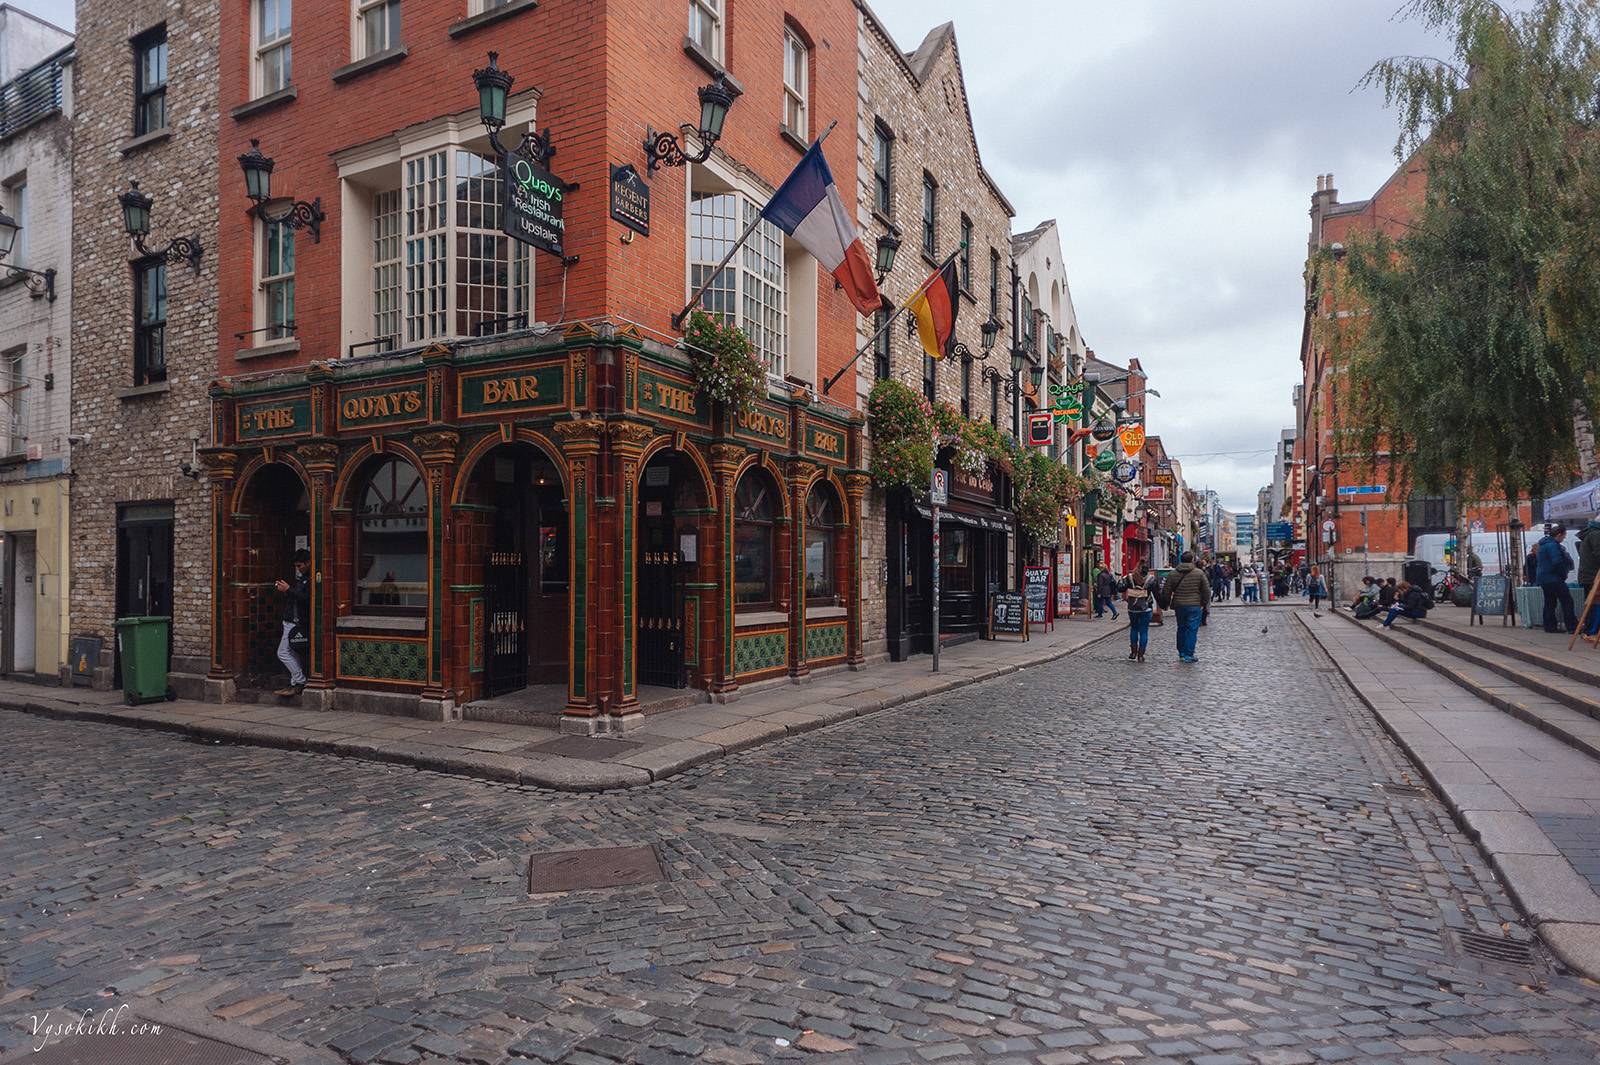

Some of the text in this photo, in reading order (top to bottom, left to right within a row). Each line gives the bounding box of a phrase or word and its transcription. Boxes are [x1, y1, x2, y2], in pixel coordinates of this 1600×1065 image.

[515, 159, 562, 202] Quays
[530, 194, 551, 212] Irish
[614, 181, 648, 209] REGENT
[514, 197, 565, 231] Restaurant
[615, 195, 648, 221] BARBERS
[521, 217, 558, 243] Upstairs
[483, 375, 539, 404] BAR
[655, 382, 697, 415] THE
[1048, 383, 1084, 395] Quays
[253, 406, 295, 431] THE
[814, 429, 838, 454] BAR
[1124, 432, 1143, 440] OLD
[1025, 569, 1050, 577] QUAYS
[1481, 577, 1502, 586] FREE
[1028, 609, 1045, 622] PEN
[1477, 599, 1502, 608] CHAT
